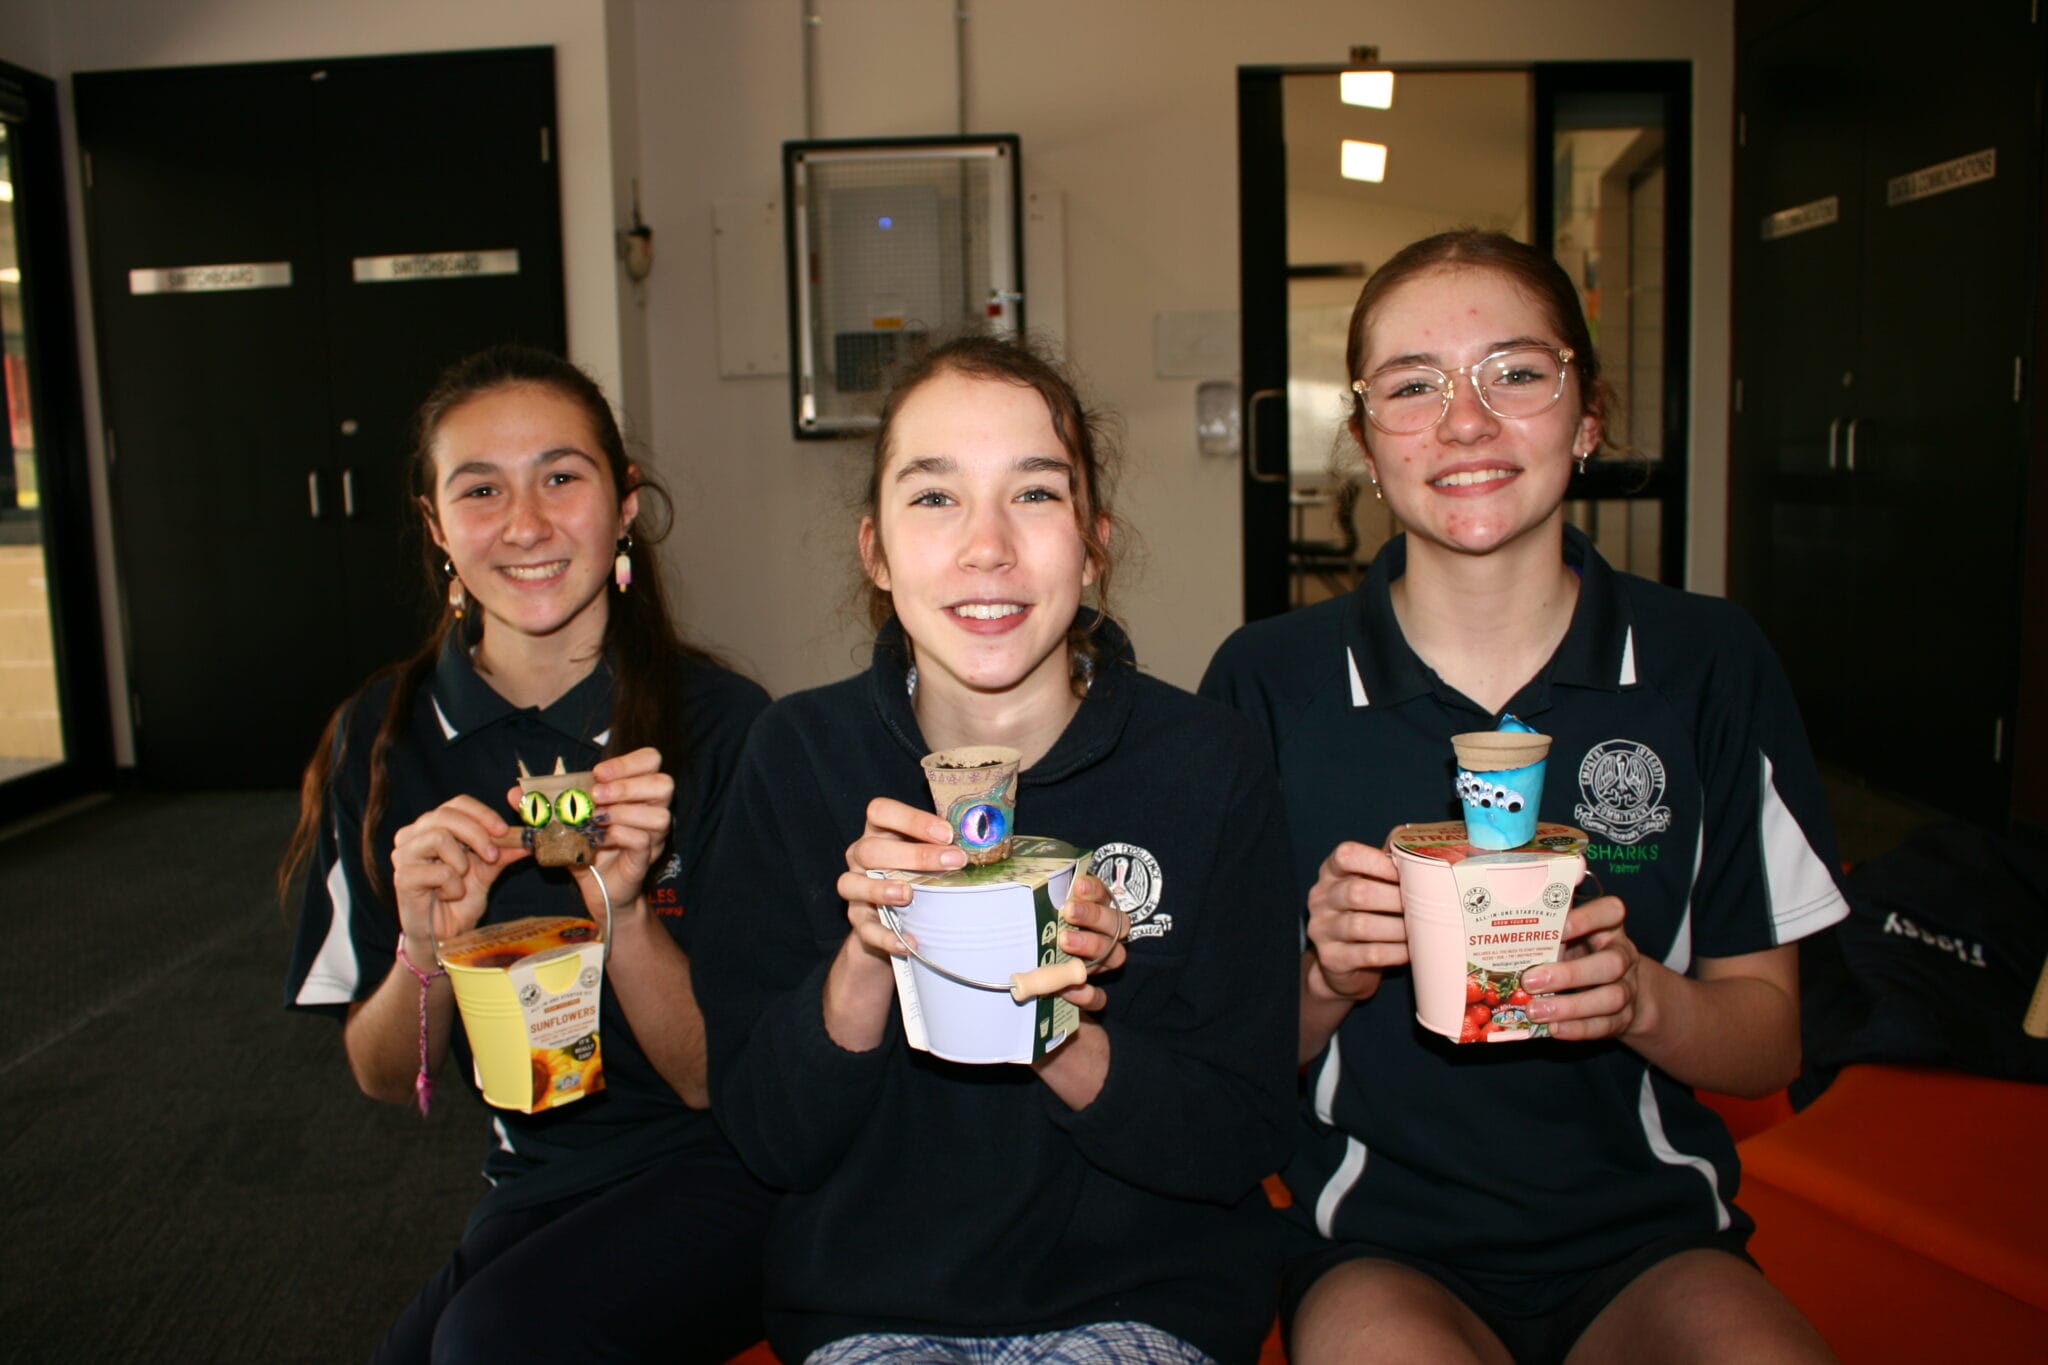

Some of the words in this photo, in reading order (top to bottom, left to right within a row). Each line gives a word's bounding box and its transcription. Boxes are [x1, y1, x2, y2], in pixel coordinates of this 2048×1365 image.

[393, 253, 479, 275] SWITCHBOARD
[168, 267, 254, 287] SWITCHBOARD
[1595, 802, 1650, 822] COMMITMENT
[1586, 844, 1659, 860] SHARKS
[1469, 929, 1560, 946] STRAWBERRIES
[530, 1006, 596, 1034] SUNFLOWERS
